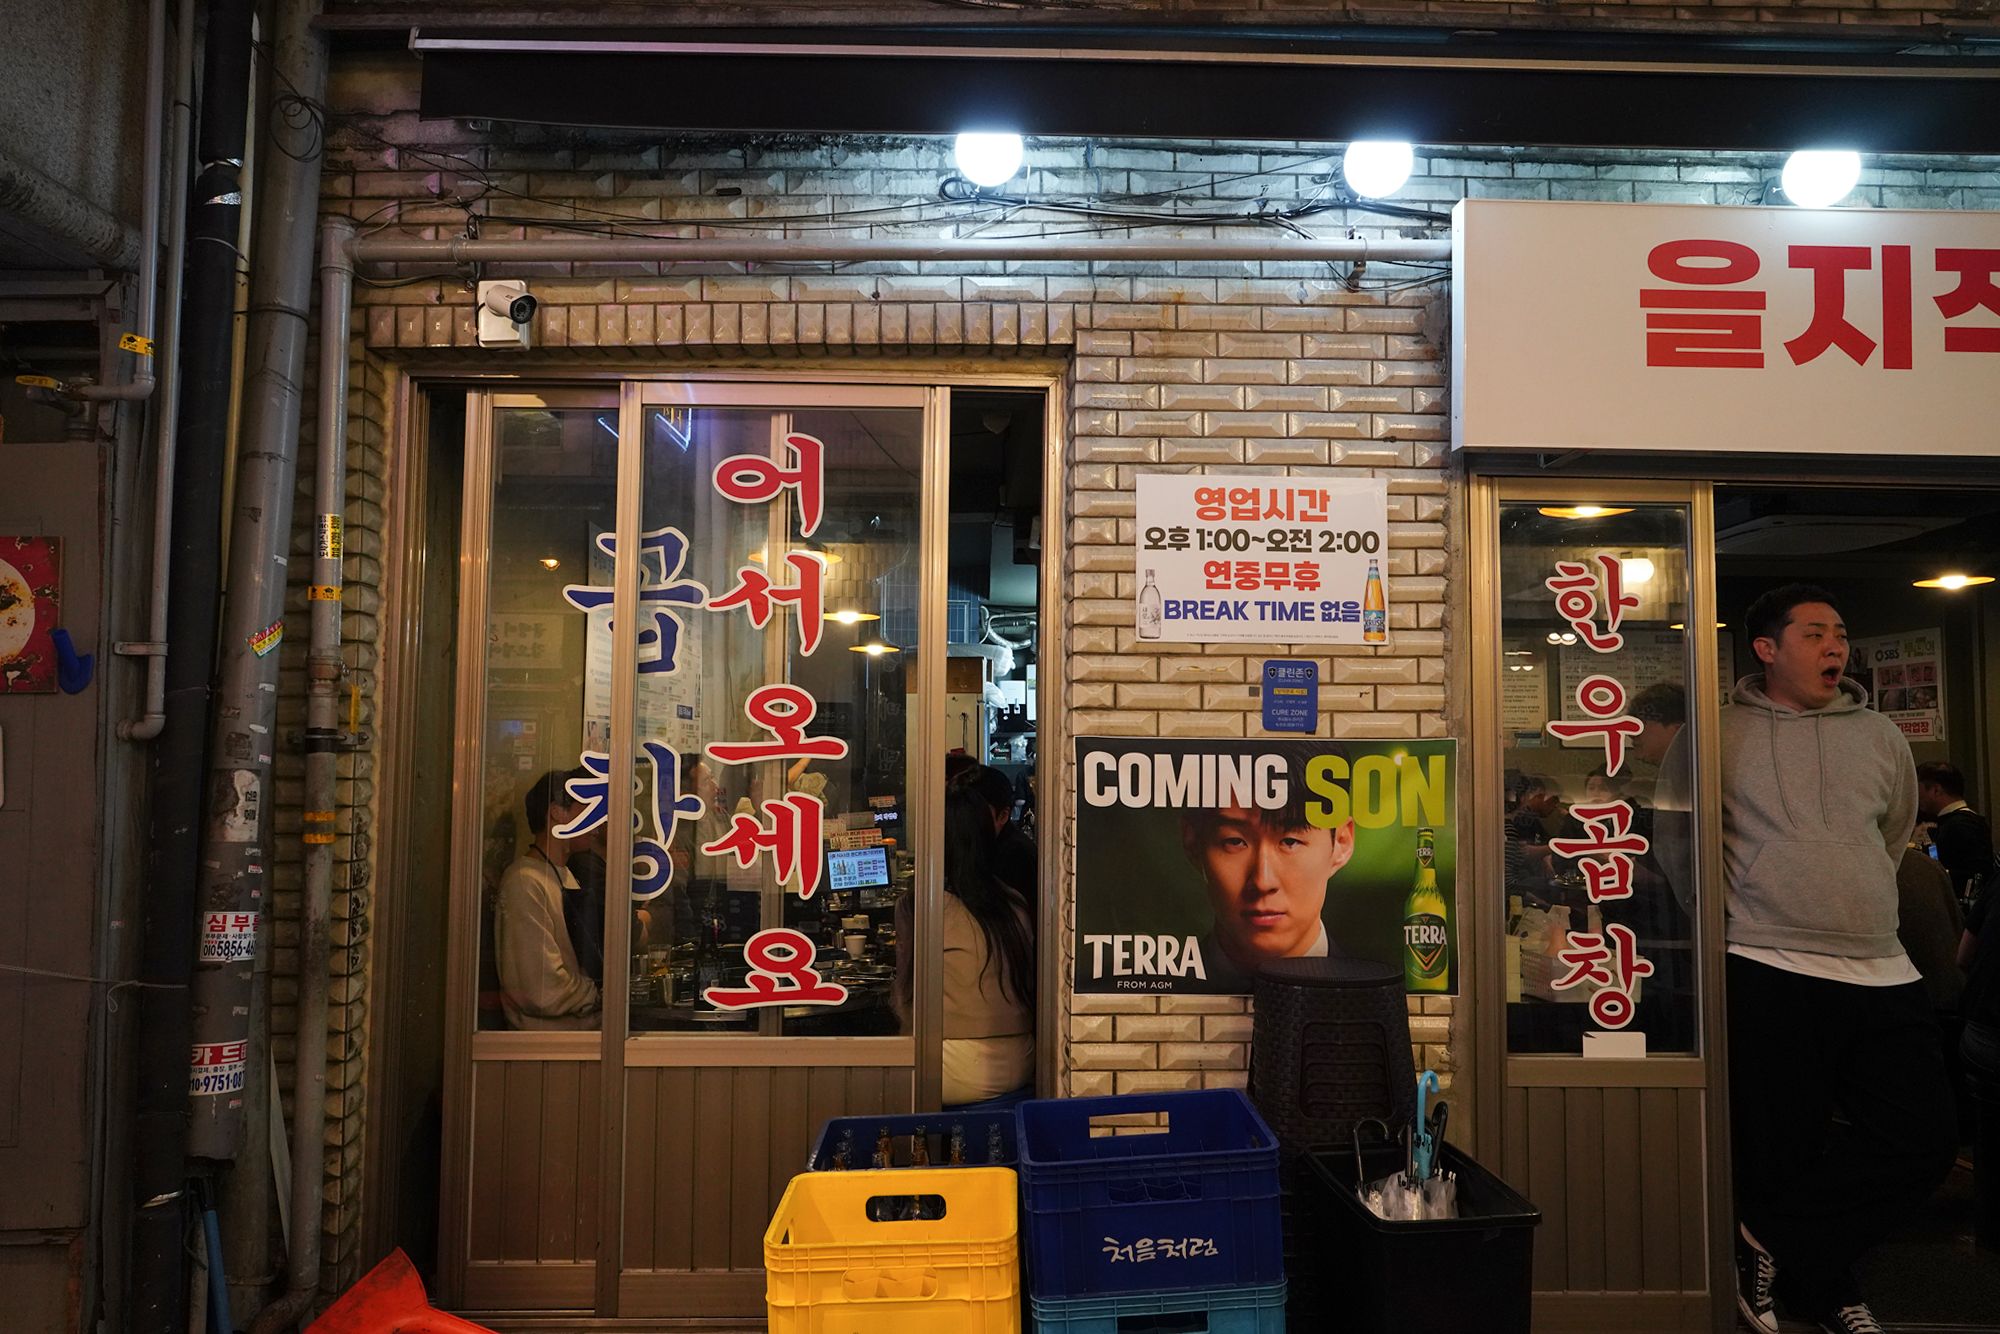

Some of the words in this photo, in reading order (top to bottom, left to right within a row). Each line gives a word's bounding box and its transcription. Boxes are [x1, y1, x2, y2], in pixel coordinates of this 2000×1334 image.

[1193, 487, 1331, 523] 영업시간
[1143, 526, 1191, 552] 오후
[1195, 527, 1313, 554] 1:00~오전
[1318, 529, 1380, 554] 2:00
[1202, 560, 1321, 592] 연중무휴
[1164, 600, 1249, 621] BREAK
[1254, 601, 1315, 622] TIME
[1319, 600, 1361, 624] 없음
[1278, 667, 1304, 678] 클린존
[704, 432, 848, 1010] 어서오세요
[1083, 751, 1288, 809] COMING
[1304, 753, 1446, 829] SON
[1546, 552, 1656, 1030] 한우곱창
[1403, 925, 1448, 945] TERRA
[1083, 934, 1208, 981] TERRA
[1116, 981, 1147, 989] FROM
[1150, 981, 1173, 989] AGM
[1102, 1236, 1219, 1263] 처음처럼
